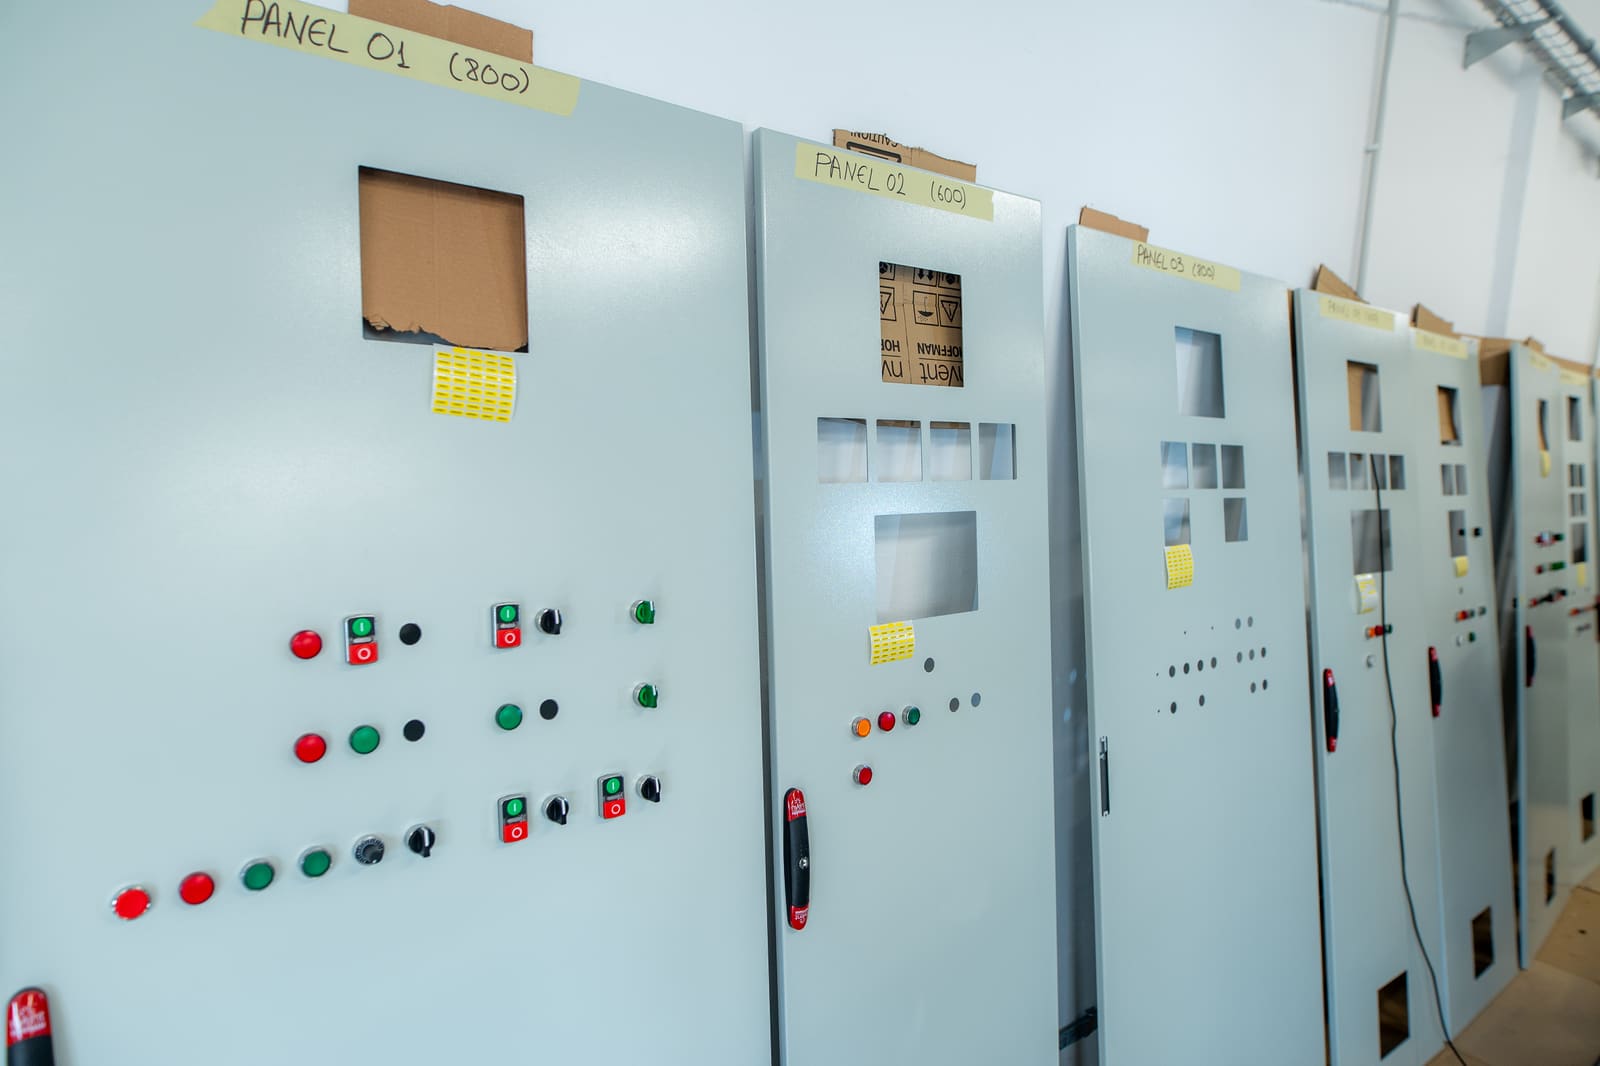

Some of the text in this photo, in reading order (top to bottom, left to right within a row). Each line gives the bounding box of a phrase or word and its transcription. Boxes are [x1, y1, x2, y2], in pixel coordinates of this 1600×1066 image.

[240, 0, 530, 94] PANEL 01 (800)
[814, 152, 967, 210] PANEL 02 (600)
[1137, 243, 1168, 270] PANEL
[1170, 256, 1185, 273] 03
[917, 343, 962, 357] OFFMAN
